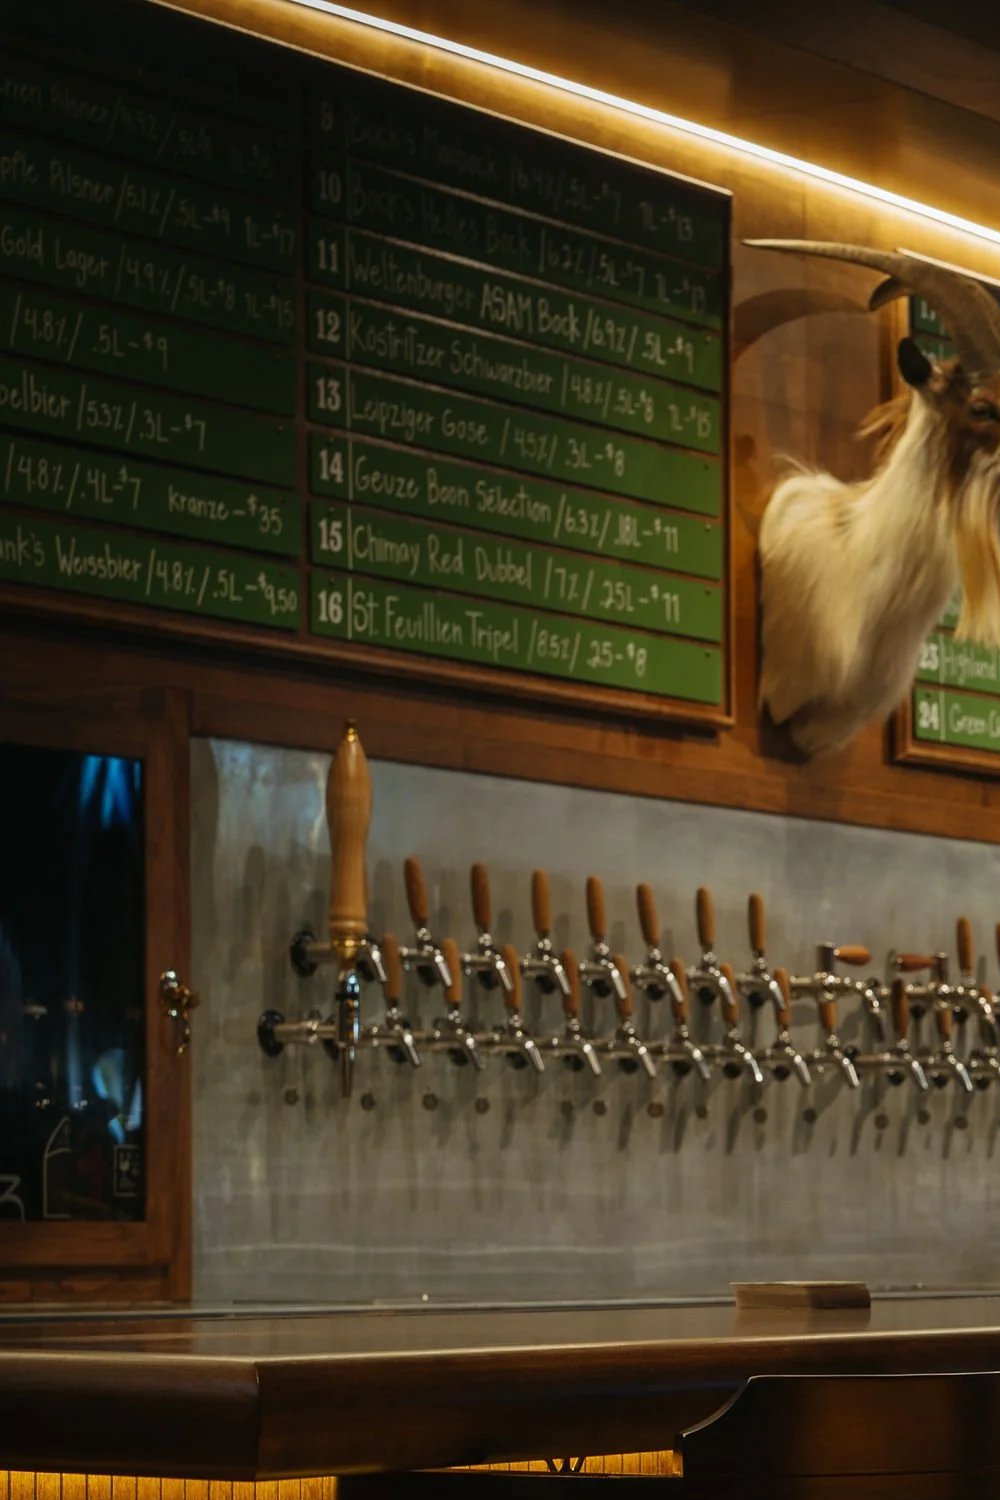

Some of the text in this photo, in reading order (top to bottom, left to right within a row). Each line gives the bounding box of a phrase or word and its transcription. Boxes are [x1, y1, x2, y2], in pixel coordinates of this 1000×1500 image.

[50, 158, 115, 203] Pilsner
[316, 170, 341, 205] 10
[0, 224, 45, 268] Gold
[54, 236, 111, 288] Lager
[317, 239, 339, 274] 11
[350, 241, 475, 315] Weltenburger
[480, 282, 534, 336] ASAM
[537, 297, 581, 344] Bock
[315, 308, 342, 343] 12
[451, 338, 554, 394] Schwarzbier
[316, 376, 342, 412] 13
[351, 381, 436, 442] Leipziger
[441, 408, 488, 446] Gose
[319, 448, 344, 484] 14
[354, 455, 420, 498] Geuze
[426, 467, 470, 509] Boon
[55, 533, 142, 582] Weissbier
[318, 517, 344, 553] 15
[353, 521, 421, 576] Chimay
[426, 532, 465, 575] Red
[475, 545, 532, 592] Dubbel
[317, 589, 344, 624] 16
[464, 609, 519, 661] Tripel
